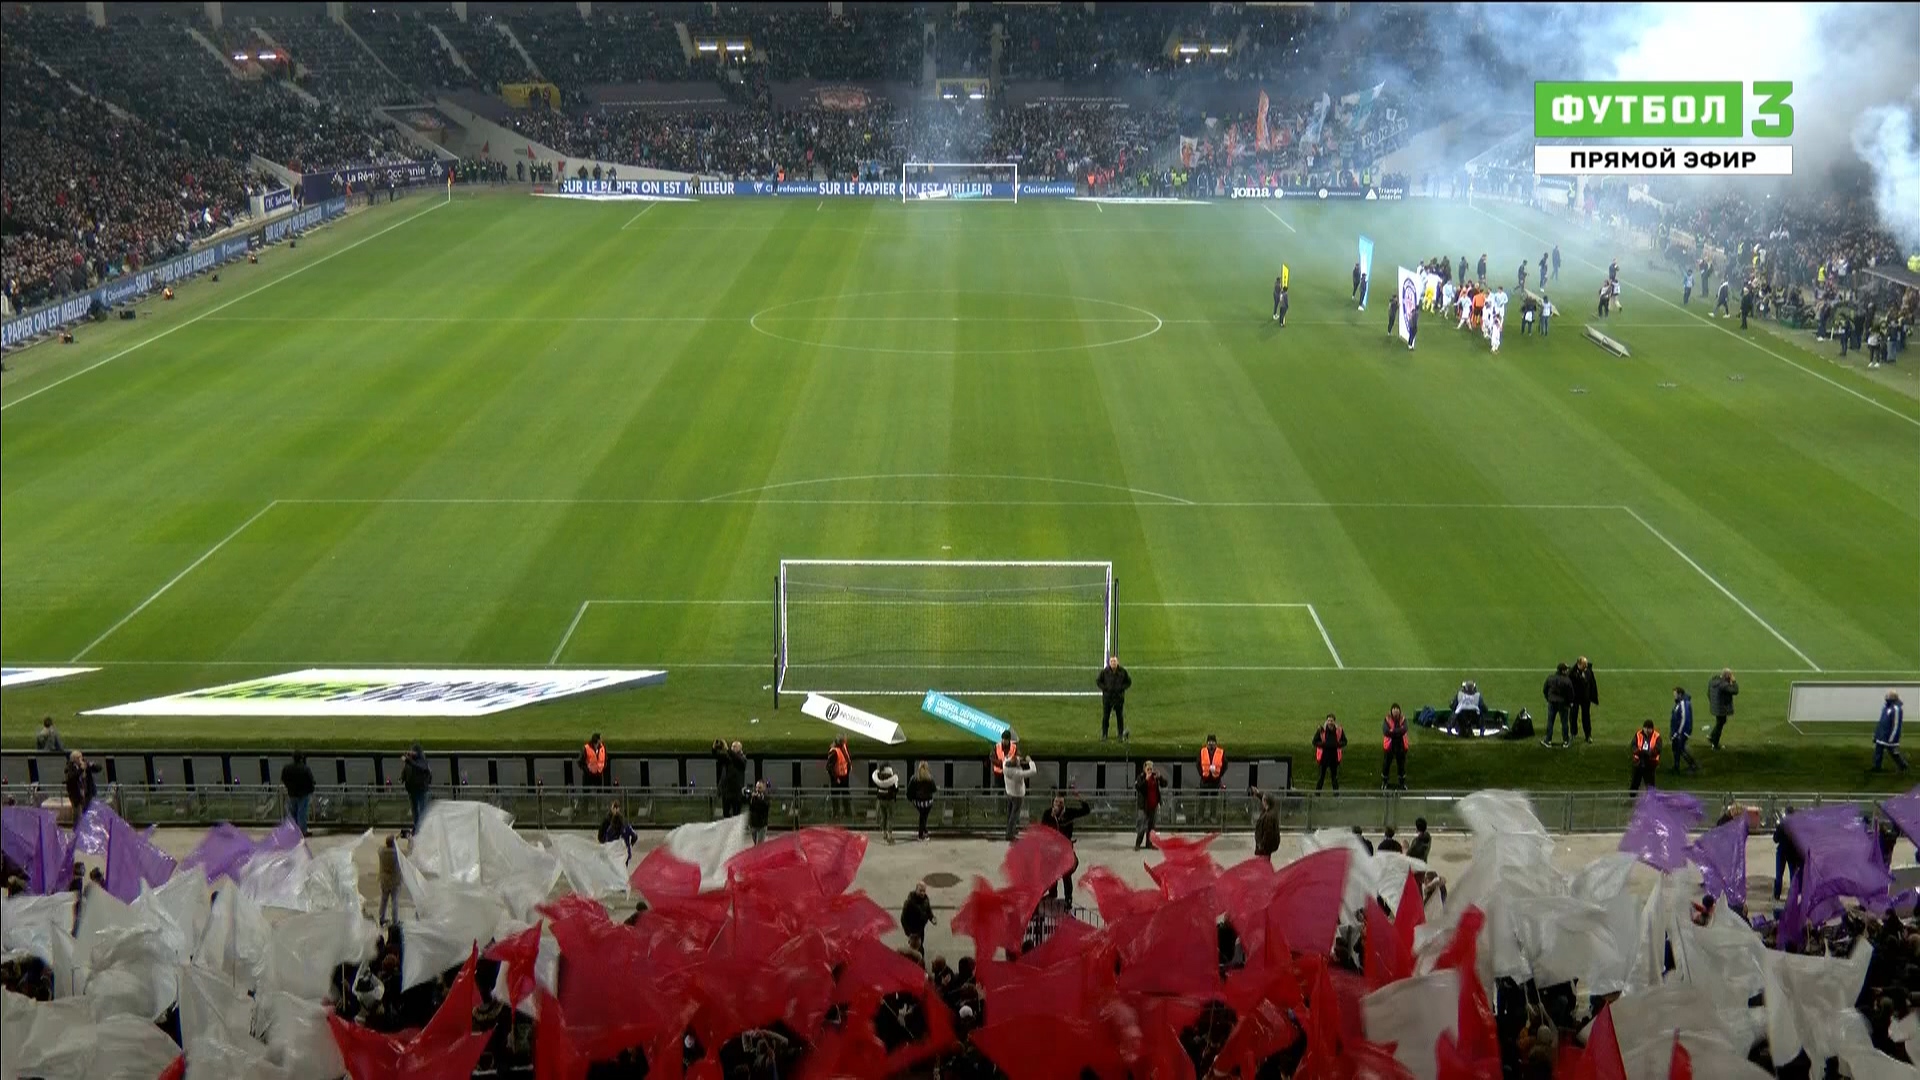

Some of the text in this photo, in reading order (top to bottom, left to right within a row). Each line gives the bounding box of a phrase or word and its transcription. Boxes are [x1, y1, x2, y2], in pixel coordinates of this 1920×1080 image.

[562, 180, 583, 193] SUR
[586, 181, 597, 193] LE
[641, 181, 660, 194] ON
[664, 181, 681, 194] EST
[684, 181, 735, 195] MILLEUR
[765, 183, 817, 193] Clirefontaine
[819, 182, 841, 195] SUR
[844, 182, 855, 195] LE
[858, 182, 896, 195] PAPIER
[900, 182, 918, 195] ON
[921, 182, 939, 194] EST
[1023, 184, 1075, 194] Clairefontaine
[7, 316, 34, 345] PAPIER
[34, 311, 48, 333] ON
[48, 307, 60, 328] EST
[60, 296, 91, 322] MEILLEUR
